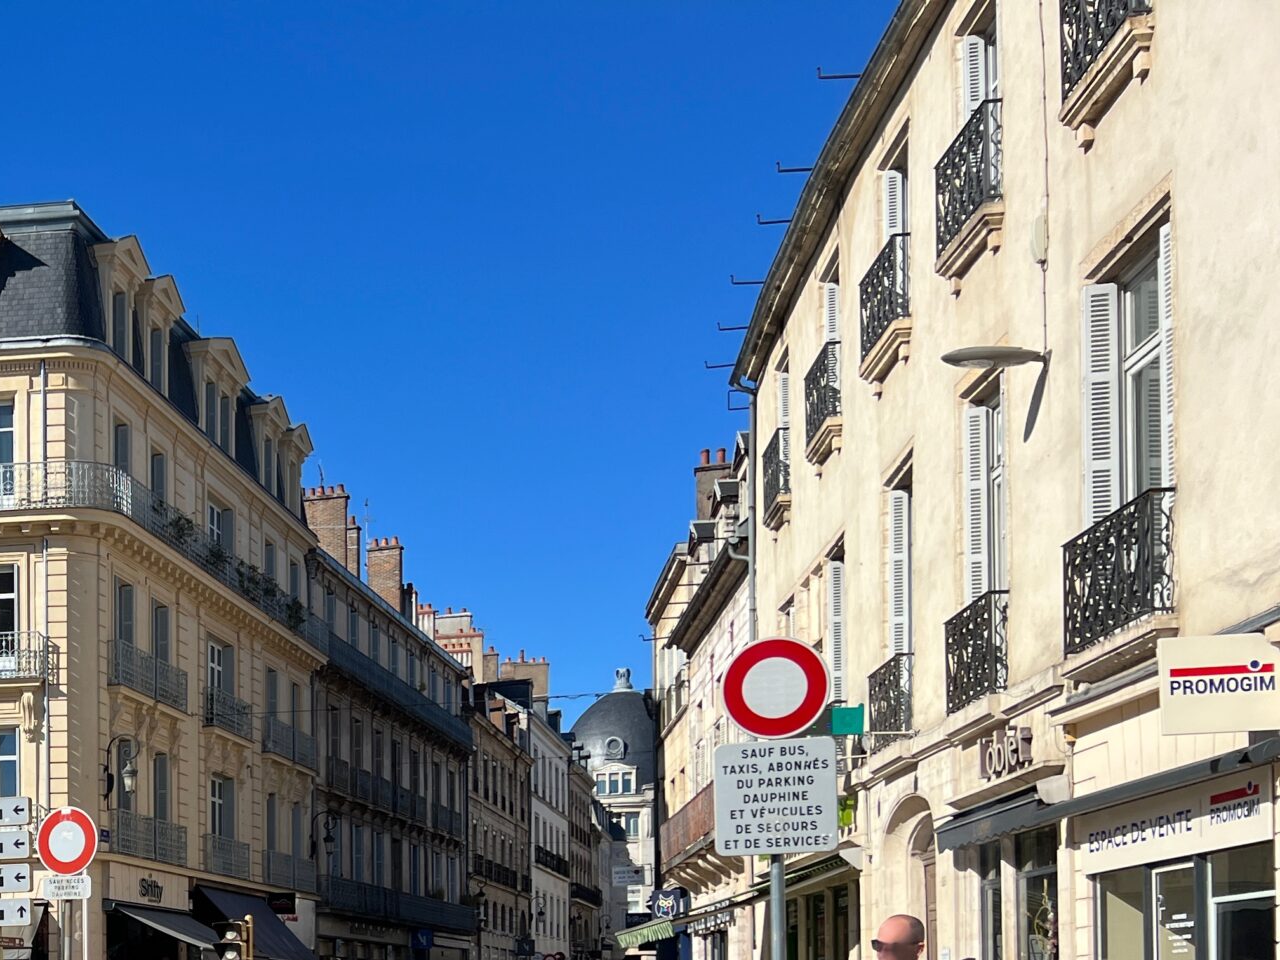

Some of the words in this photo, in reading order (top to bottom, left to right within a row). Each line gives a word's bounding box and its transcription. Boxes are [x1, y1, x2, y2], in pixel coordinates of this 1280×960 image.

[1169, 675, 1276, 696] PROMOGIM
[741, 748, 774, 759] SAUF
[780, 745, 809, 757] BUS,
[722, 764, 762, 776] TAXIS,
[768, 758, 829, 773] ABONNÉS
[737, 779, 753, 789] DU
[758, 775, 815, 788] PARKING
[743, 790, 809, 804] DAUPHINE
[730, 809, 745, 820] ET
[1209, 798, 1261, 826] PROMOGIM
[736, 824, 751, 835] DE
[757, 820, 818, 834] SECOURS
[1089, 826, 1128, 853] ESPACE
[1131, 820, 1147, 844] DE
[1149, 809, 1193, 839] VENTE
[725, 839, 739, 850] ET
[745, 839, 761, 849] DE
[767, 835, 830, 848] SERVICES
